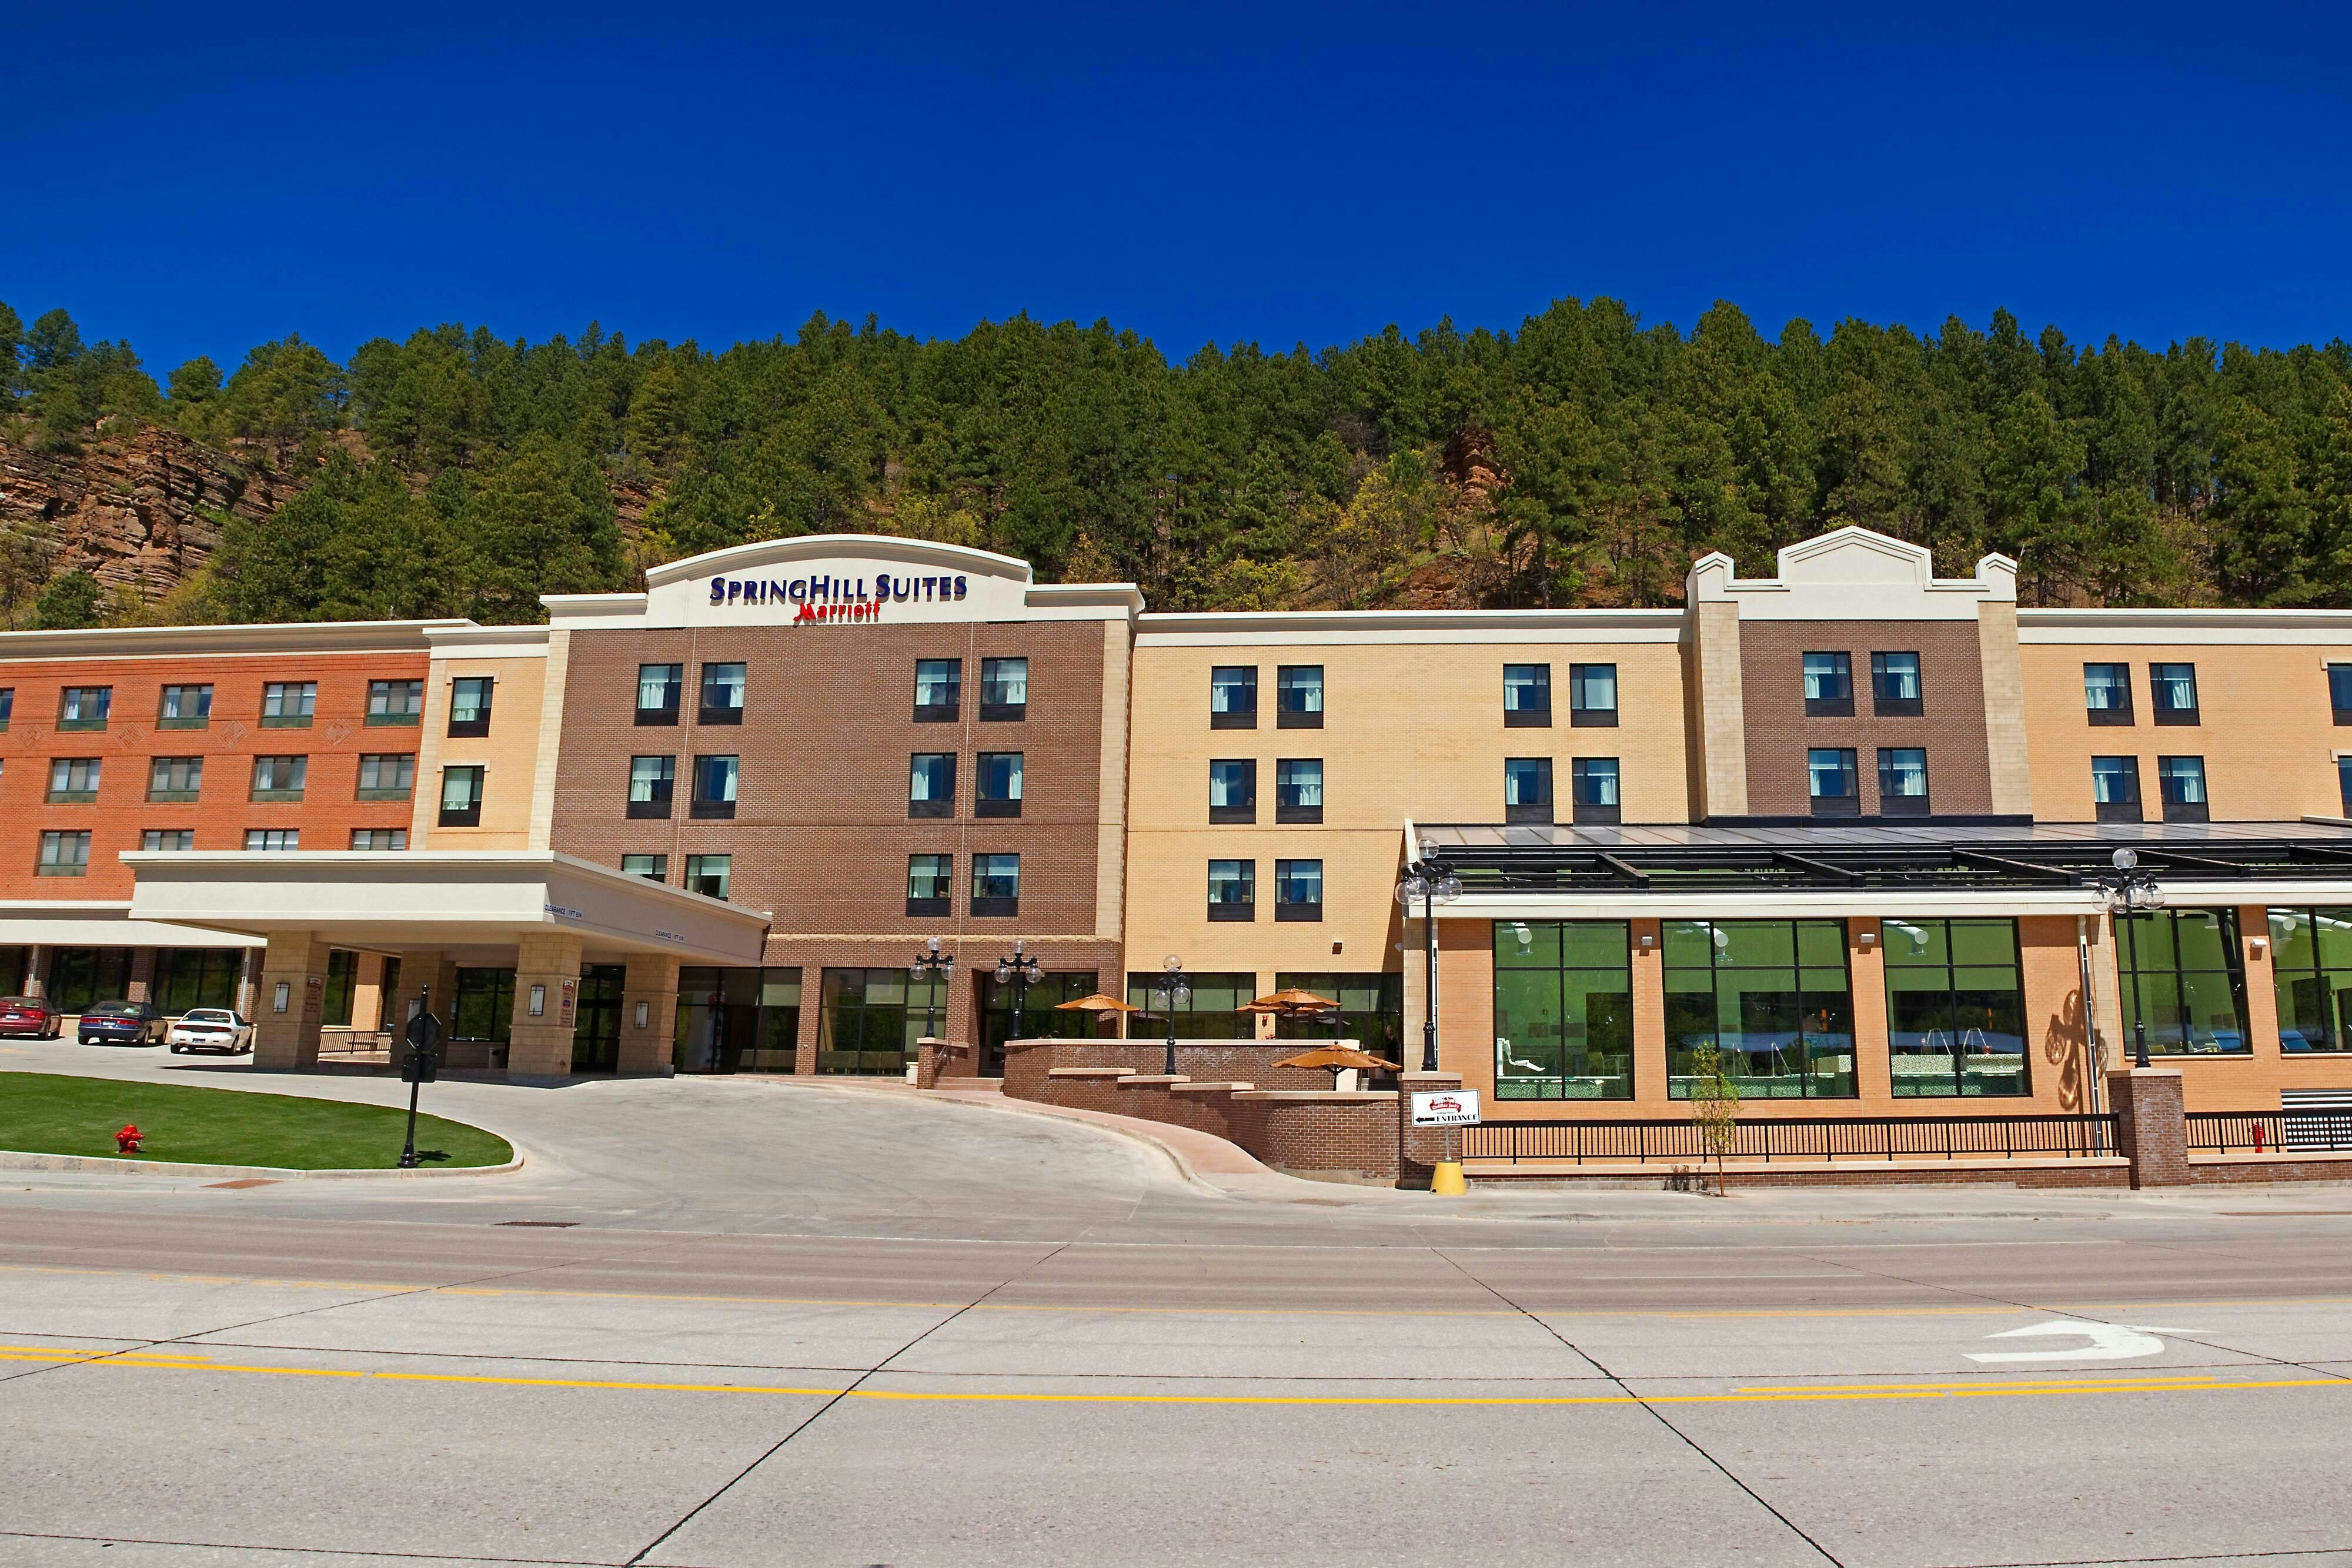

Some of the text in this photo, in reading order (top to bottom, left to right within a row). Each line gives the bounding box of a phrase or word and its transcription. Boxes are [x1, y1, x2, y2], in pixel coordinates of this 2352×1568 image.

[875, 574, 967, 597] SUITES
[793, 601, 880, 621] Marriott
[545, 904, 566, 914] CLEARANCE
[655, 930, 671, 939] CLEARANCE
